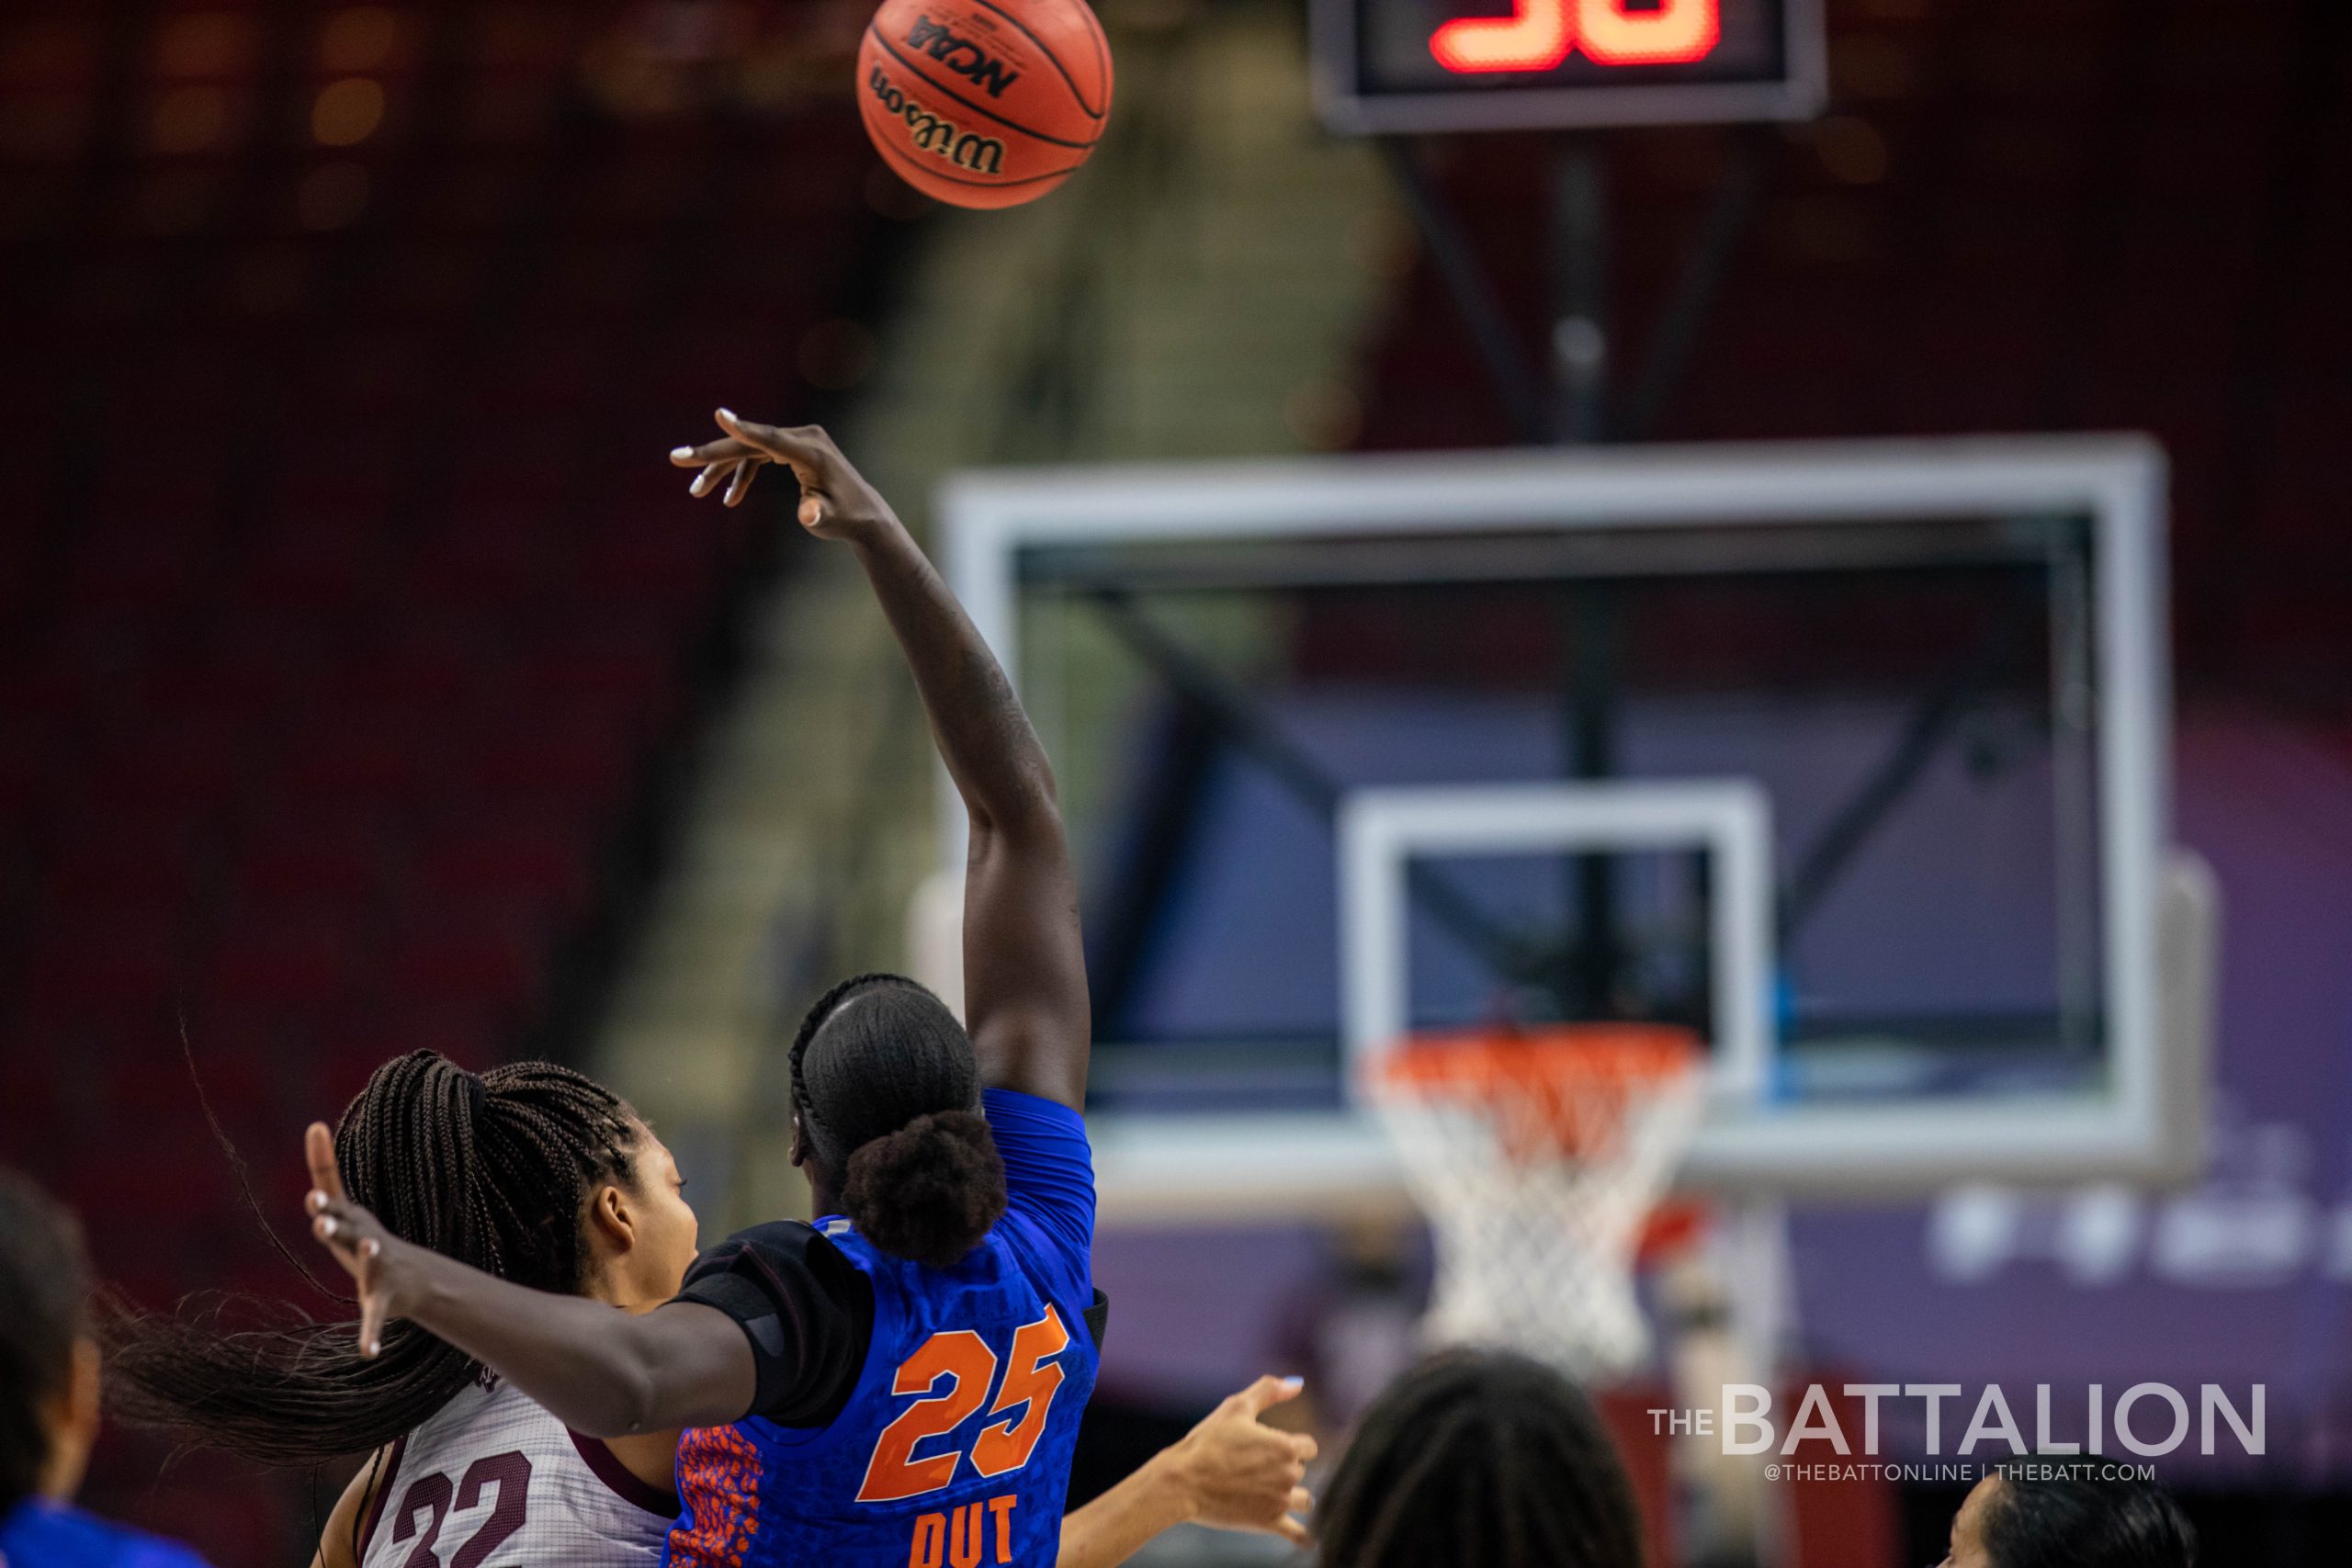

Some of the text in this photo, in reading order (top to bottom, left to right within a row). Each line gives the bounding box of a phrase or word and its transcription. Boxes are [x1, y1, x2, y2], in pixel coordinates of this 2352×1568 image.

[908, 14, 1020, 98] NCAA
[868, 61, 1006, 175] Wilson
[855, 1303, 1069, 1503] 25
[909, 1494, 1018, 1568] DUT
